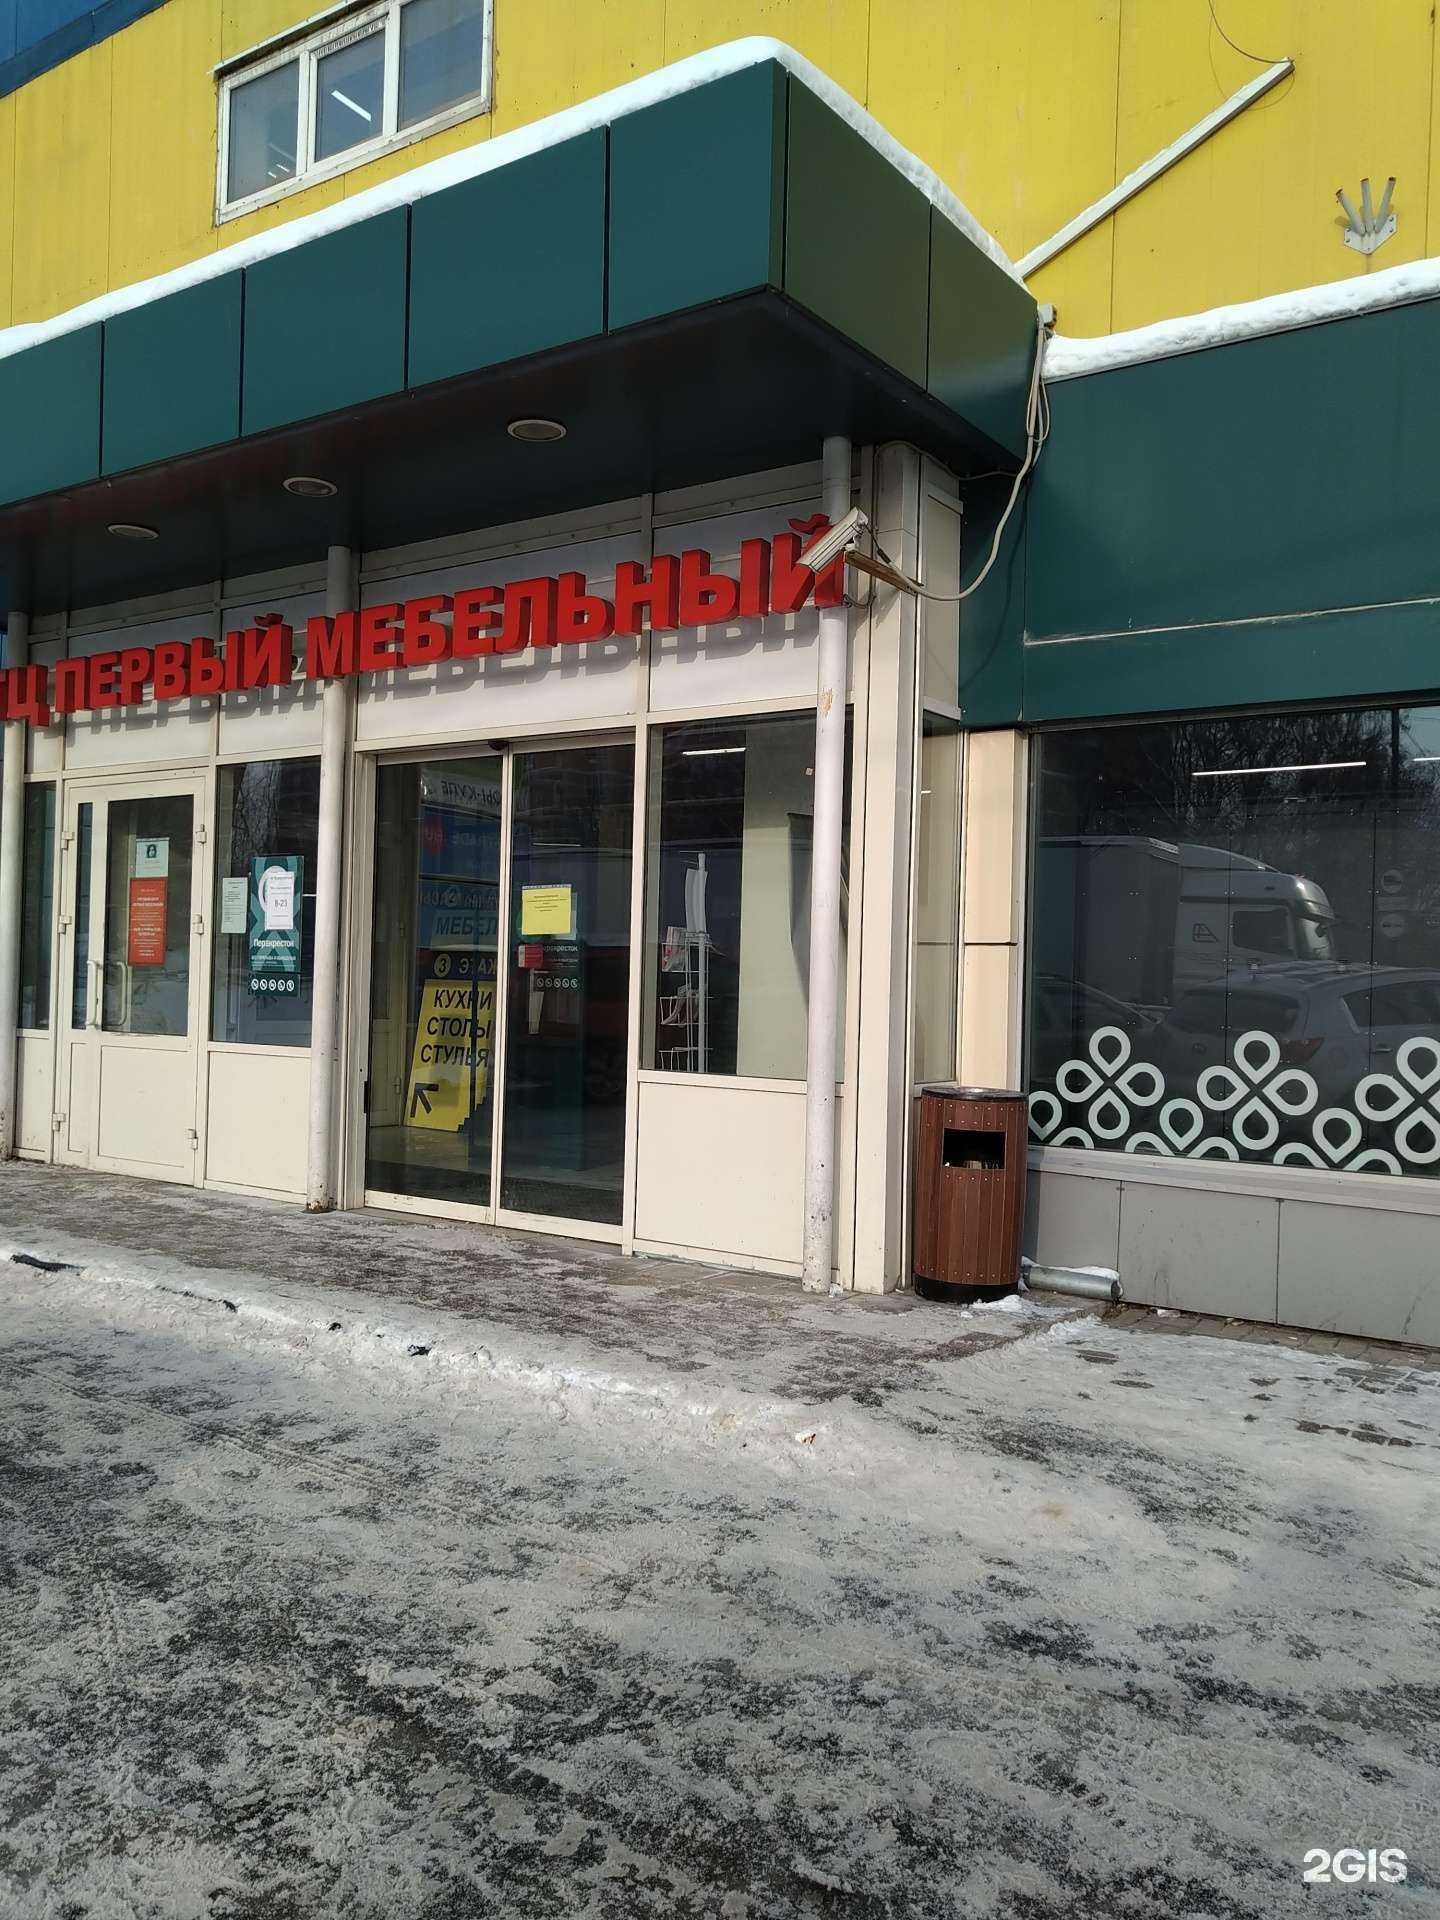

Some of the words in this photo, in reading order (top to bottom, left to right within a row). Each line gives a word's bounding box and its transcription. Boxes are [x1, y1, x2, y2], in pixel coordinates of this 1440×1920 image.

[0, 664, 49, 727] Ц
[55, 613, 293, 713] ПЕРВЫЙ
[306, 513, 845, 680] МЕБЕЛЬНЫЙ
[438, 957, 447, 974] 3
[433, 989, 493, 1010] КУХНИ
[426, 1016, 491, 1039] СТОЛЫ
[420, 1044, 490, 1068] СТУЛЬЯ
